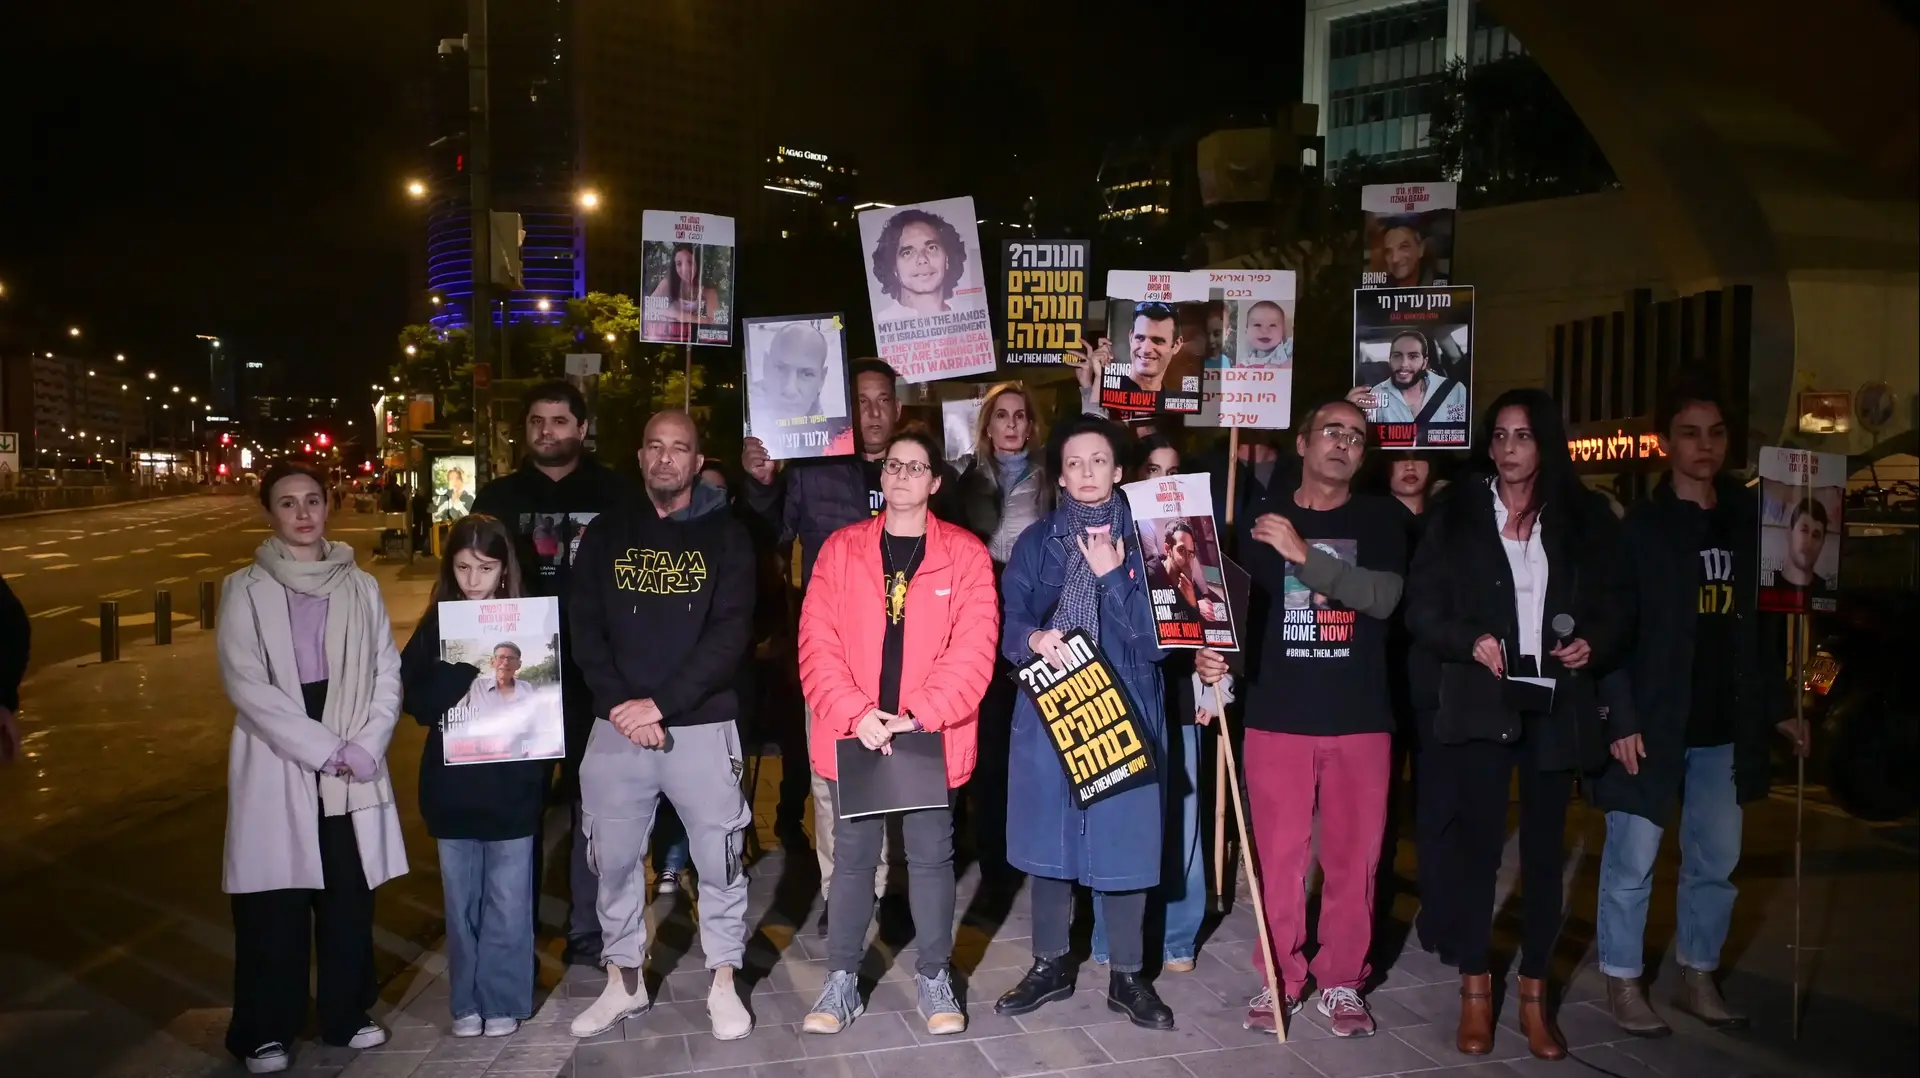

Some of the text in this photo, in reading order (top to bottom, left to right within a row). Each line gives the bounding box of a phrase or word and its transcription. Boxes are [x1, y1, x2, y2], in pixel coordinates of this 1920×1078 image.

[778, 146, 828, 162] HAGAG GROUP
[1008, 243, 1084, 268] חנוכה?
[1008, 270, 1084, 292] חטופים
[1210, 273, 1271, 282] כפיר ואריאל
[1362, 272, 1387, 284] BRING
[644, 296, 669, 308] BRING
[1008, 295, 1083, 322] חנוקים
[1378, 294, 1451, 311] מתן עדיין חי
[878, 322, 892, 334] MY
[894, 319, 916, 330] LIFE
[932, 314, 952, 326] THE
[952, 310, 986, 322] HANDS
[897, 330, 930, 342] ISRAELI
[930, 320, 986, 336] GOVERNMENT
[1007, 322, 1083, 348] בעזה!
[882, 346, 890, 355] IF
[891, 343, 912, 354] THEY
[939, 336, 958, 346] SIGN
[960, 335, 965, 344] A
[966, 332, 988, 343] DEAL
[885, 342, 990, 365] THEY ARE SIGNING MY
[1006, 353, 1019, 364] ALL
[1023, 353, 1042, 364] THEM
[1042, 353, 1062, 364] HOME
[894, 352, 992, 376] EATH WARRANT!
[1104, 362, 1131, 376] BRING
[1104, 375, 1121, 389] HIM
[1226, 371, 1248, 381] אם
[1252, 371, 1274, 381] מה
[1103, 390, 1156, 406] HOME NOW!
[1258, 392, 1276, 402] היו
[1218, 412, 1258, 425] שלך?
[780, 430, 830, 449] אלעד קצי
[1388, 423, 1417, 440] NOW!
[1428, 434, 1465, 442] FAMILIES FORUM
[1606, 429, 1634, 460] ולא
[614, 548, 706, 572] STAM
[614, 568, 706, 594] WARS
[1760, 571, 1774, 587] HIM
[1152, 589, 1176, 605] BRING
[1155, 605, 1172, 620] HIM
[1284, 610, 1314, 624] BRING
[1159, 621, 1202, 638] HOME NOW!
[1283, 624, 1354, 642] HOME NOW!
[1286, 648, 1350, 658] #BRING_THEM_HOME
[1037, 661, 1112, 722] חטופים
[448, 706, 479, 723] BRING
[1050, 687, 1127, 751] חנוקים
[1064, 720, 1142, 784] בעזה!
[1079, 786, 1093, 801] ALL
[1093, 778, 1112, 793] THEM
[1110, 764, 1131, 784] HOME
[1128, 754, 1148, 775] NOW!
